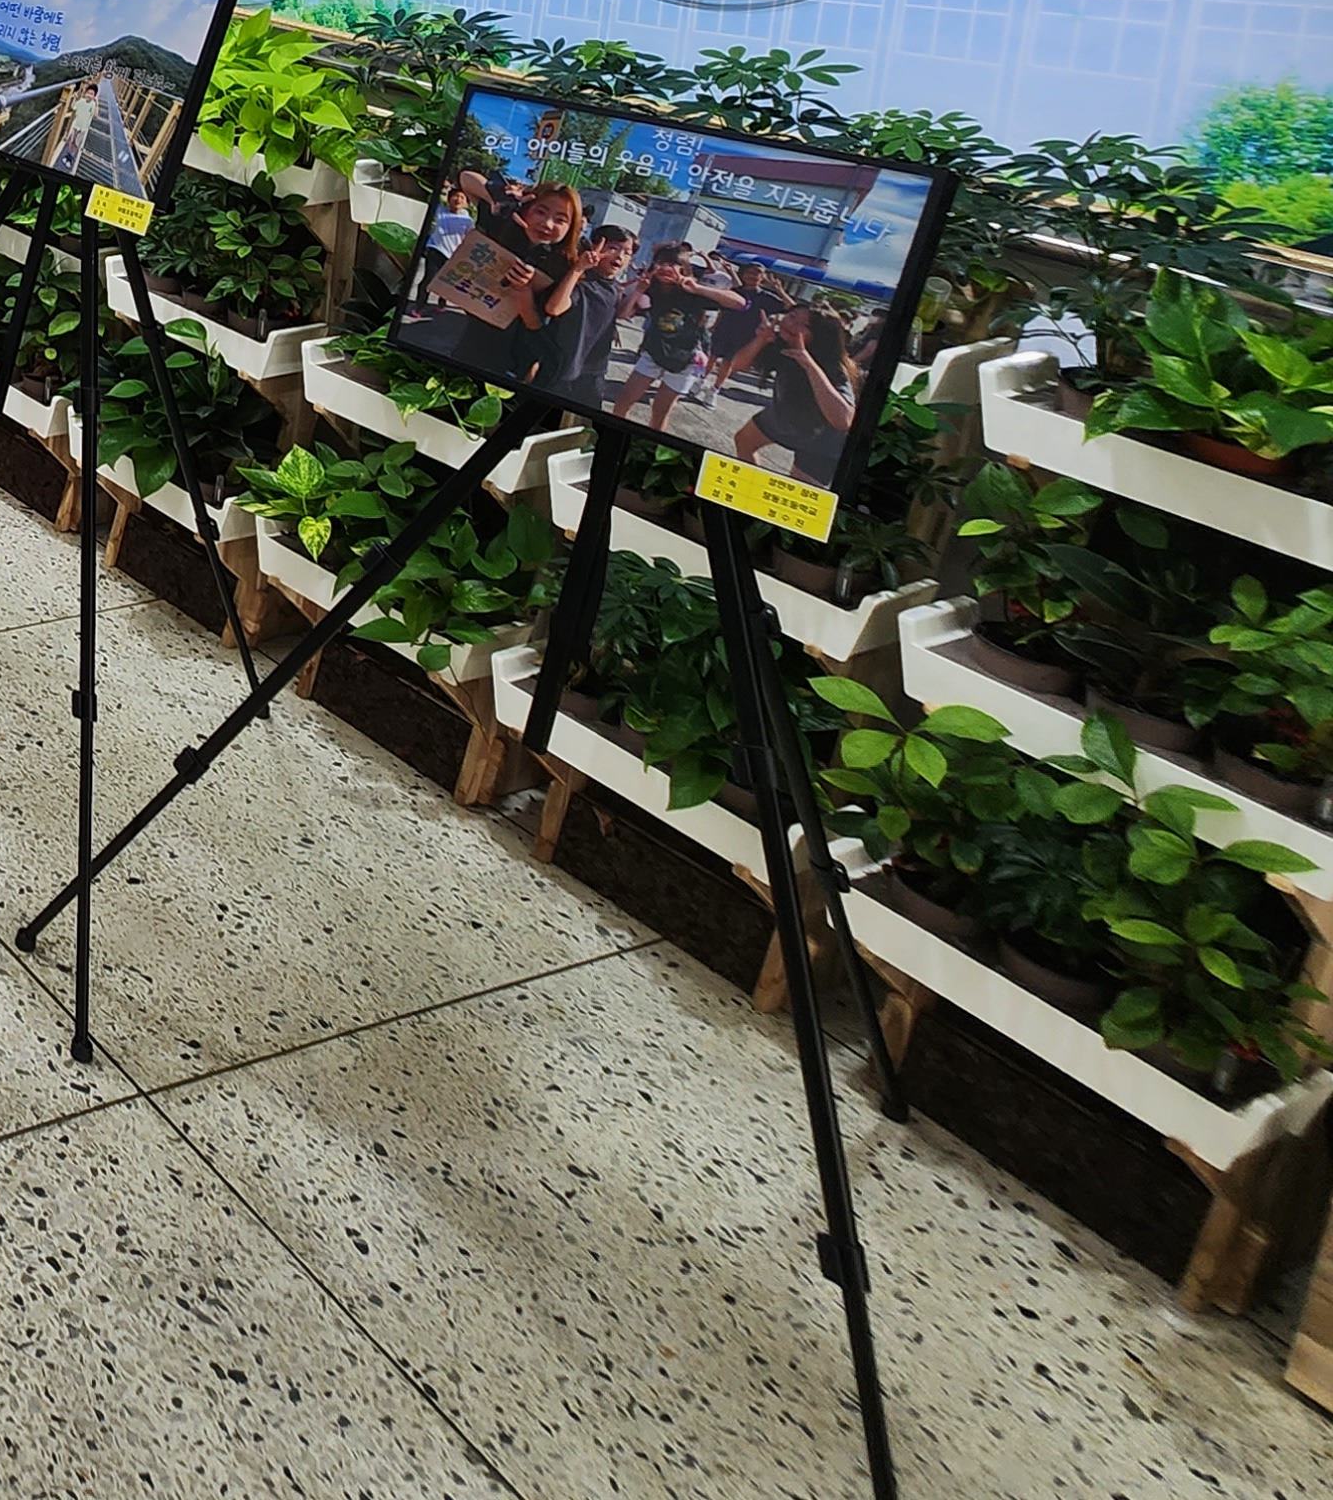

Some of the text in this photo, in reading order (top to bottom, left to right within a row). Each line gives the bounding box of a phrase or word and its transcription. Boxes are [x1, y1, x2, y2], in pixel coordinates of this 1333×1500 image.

[0, 0, 64, 26] 어떤 바람에도
[18, 27, 38, 47] 않는
[72, 53, 103, 77] 다리를
[653, 127, 704, 159] 청렴!
[481, 131, 520, 156] 우리
[526, 138, 608, 167] 아이들의
[614, 150, 679, 181] 웃음과
[687, 162, 758, 203] 안전을
